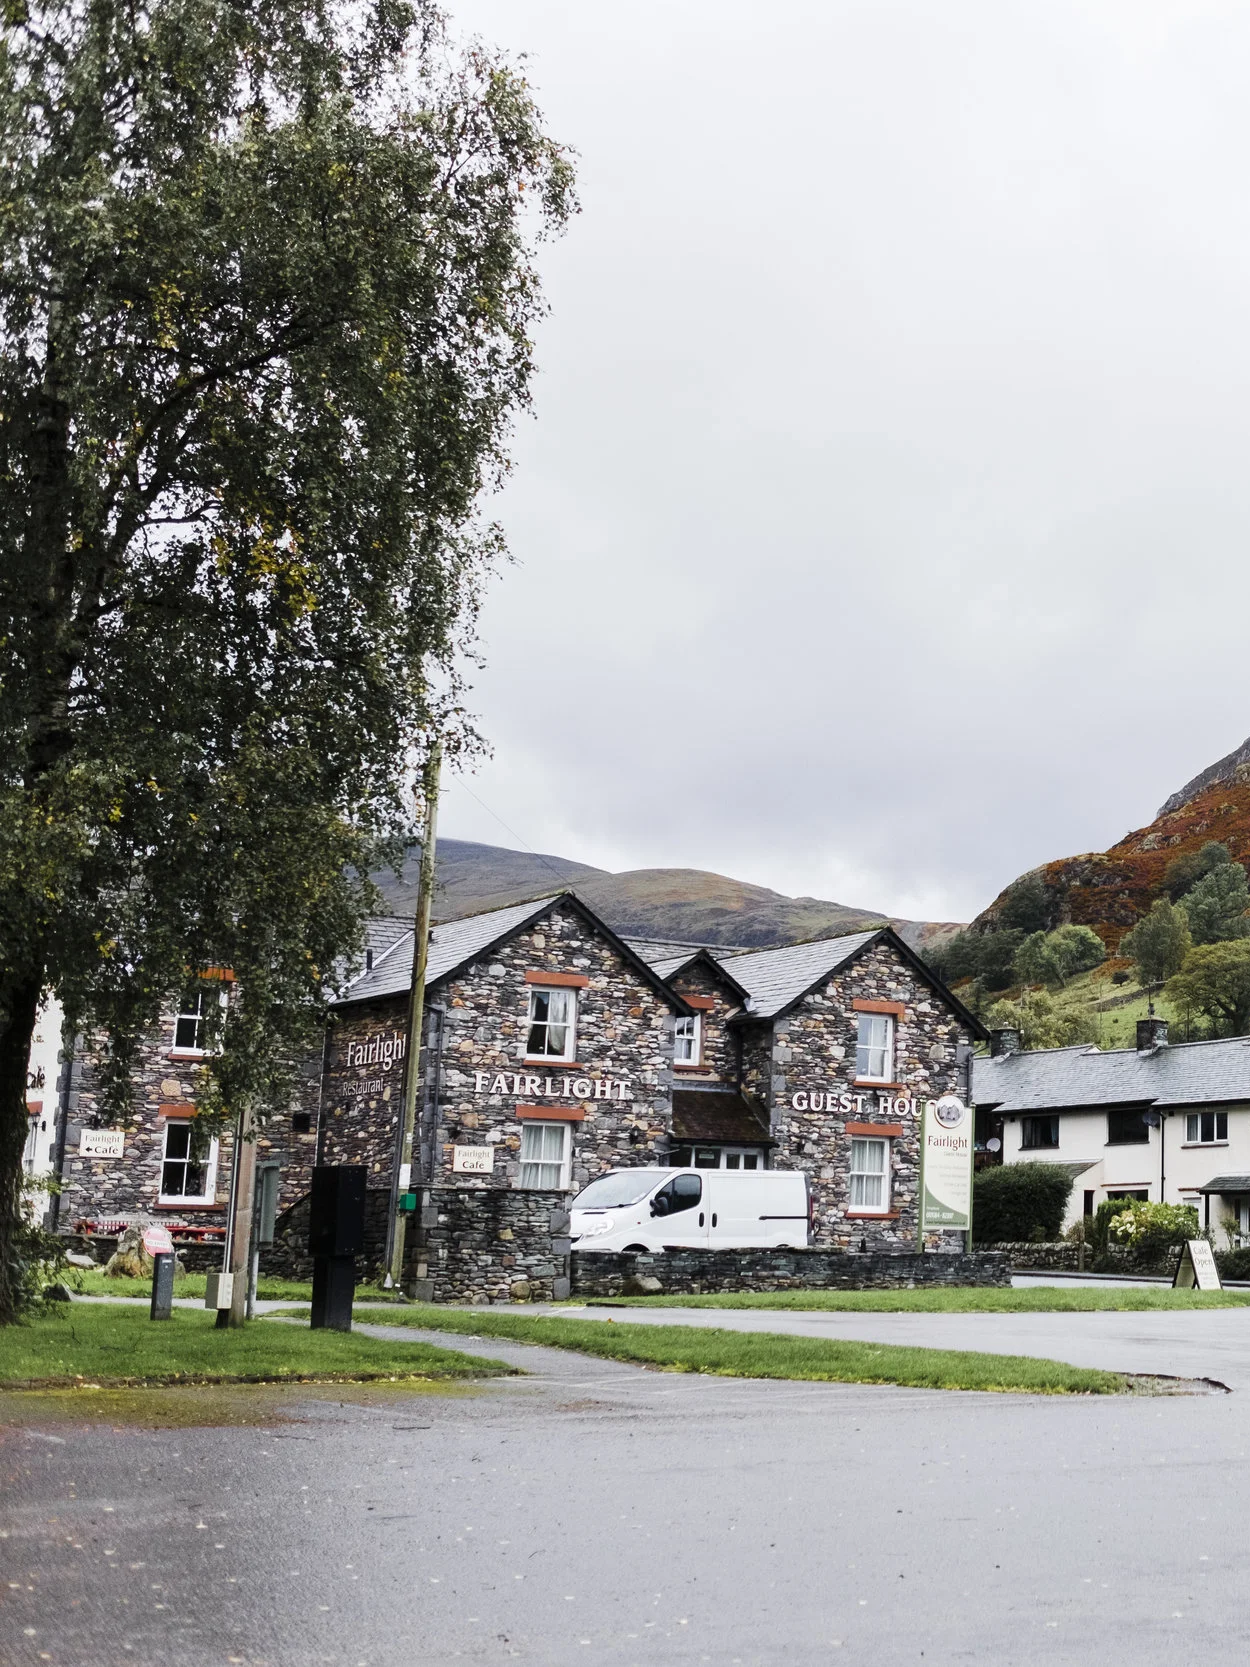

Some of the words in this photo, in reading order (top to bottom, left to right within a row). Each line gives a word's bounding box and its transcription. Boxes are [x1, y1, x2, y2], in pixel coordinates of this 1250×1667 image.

[346, 1032, 406, 1071] Fairlight
[342, 1077, 384, 1096] Restaurant
[473, 1073, 632, 1100] FAIRLIGHT
[792, 1091, 867, 1114] GUEST
[879, 1096, 936, 1117] HOU
[86, 1135, 120, 1144] Fairlight
[928, 1135, 968, 1151] Fairlight
[94, 1146, 119, 1154] Cafe
[458, 1150, 490, 1160] Fairlight
[462, 1161, 485, 1169] Cafe
[1195, 1257, 1213, 1268] Open
